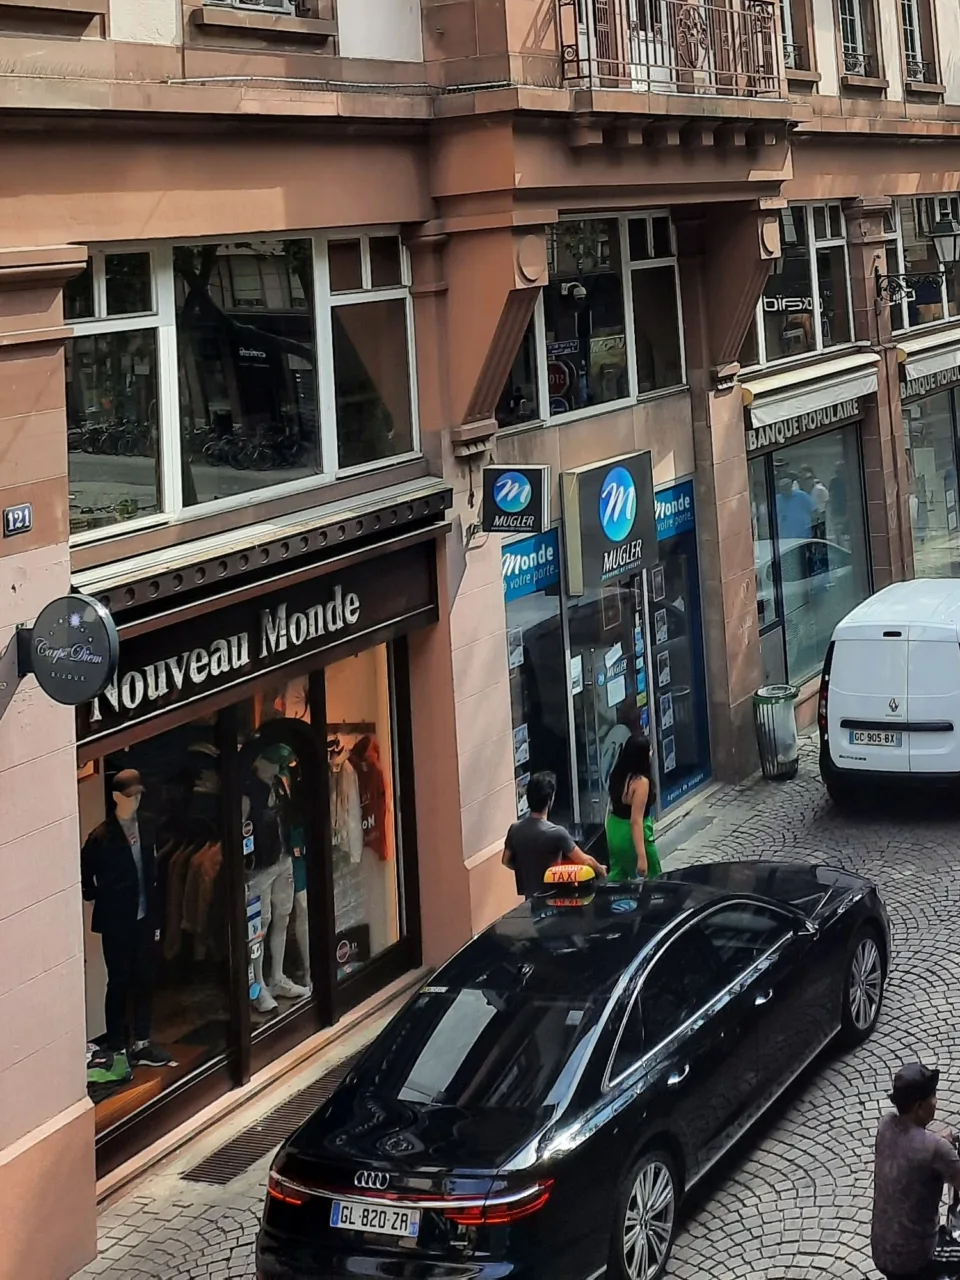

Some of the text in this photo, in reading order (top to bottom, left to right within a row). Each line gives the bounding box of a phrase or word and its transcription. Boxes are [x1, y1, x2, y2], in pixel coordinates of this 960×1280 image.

[900, 373, 936, 399] BANQUE
[747, 398, 860, 451] BANQUE POPULAIRE
[7, 510, 31, 531] 121
[493, 515, 535, 527] MUGLER
[501, 543, 554, 577] Monde
[603, 539, 643, 573] MUGLER
[510, 573, 531, 589] votre
[34, 637, 103, 664] Carpe Diem
[90, 584, 361, 722] Nouveau Monde
[551, 872, 578, 882] TAXI
[340, 1205, 409, 1232] GL-820-ZA
